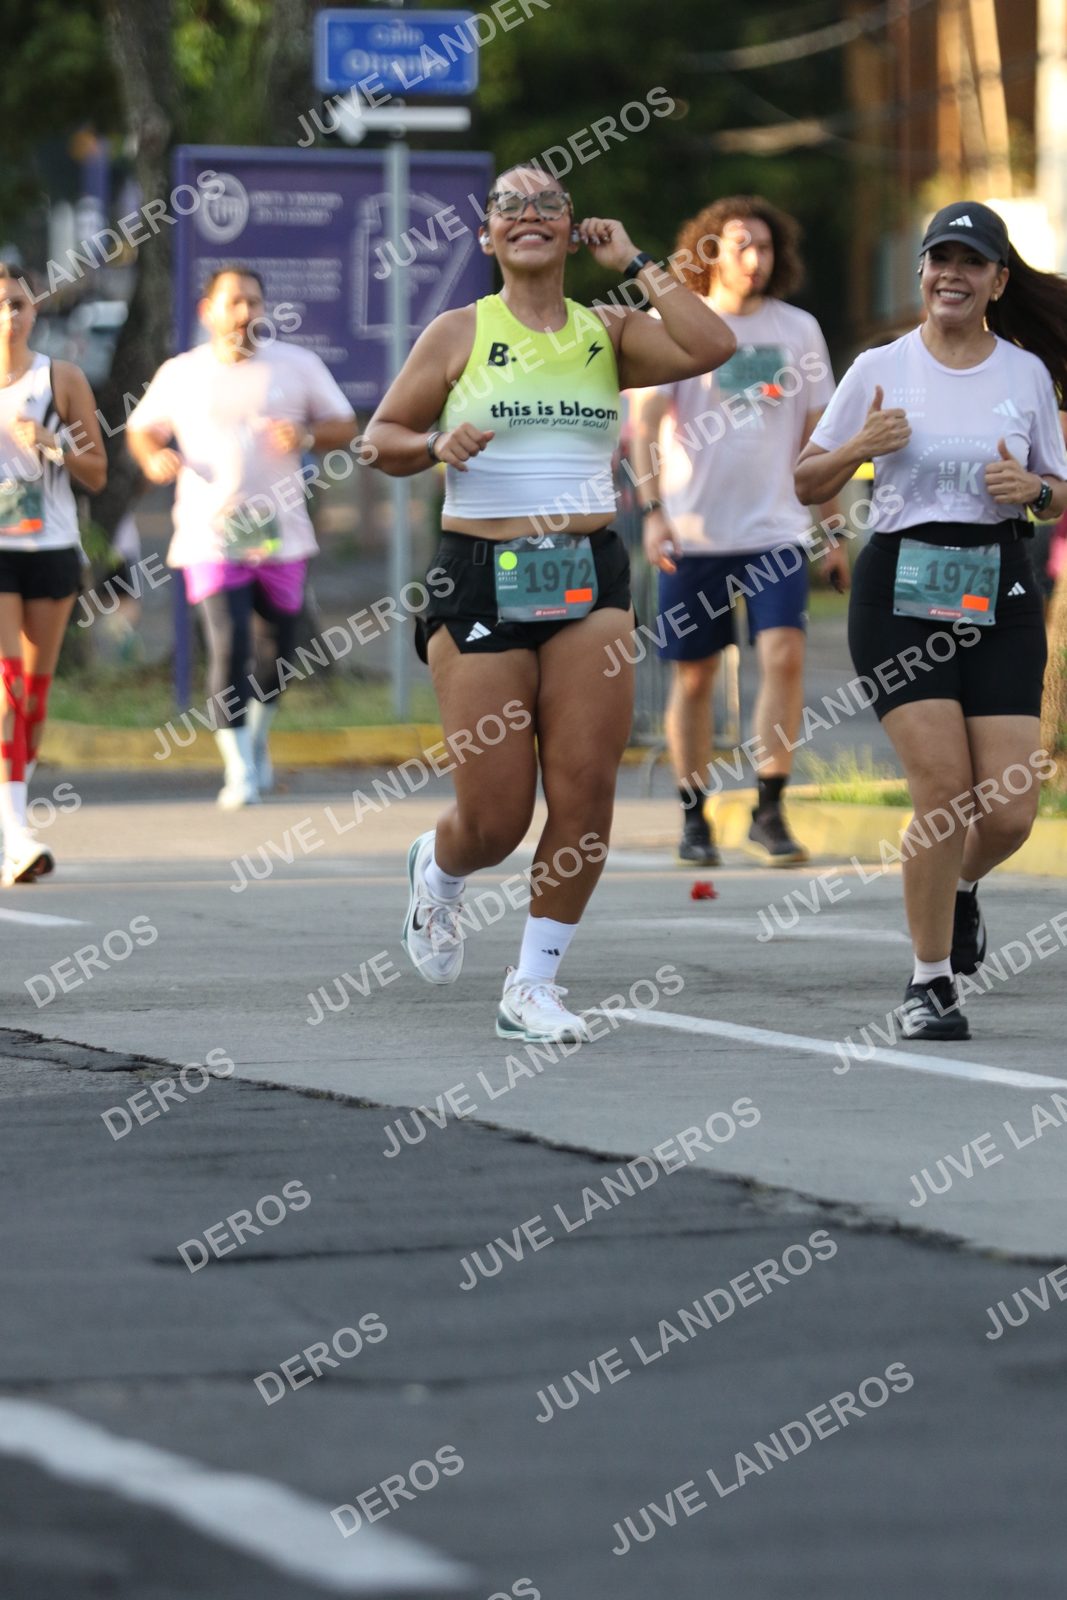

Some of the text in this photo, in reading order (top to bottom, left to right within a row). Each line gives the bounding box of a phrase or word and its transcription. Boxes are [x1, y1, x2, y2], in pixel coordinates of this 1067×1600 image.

[490, 401, 618, 420] this is bloom
[509, 416, 610, 430] (move your soul)
[938, 461, 956, 475] 15
[938, 480, 955, 493] 30
[960, 462, 982, 496] K
[524, 558, 595, 593] 1972
[924, 560, 996, 596] 1973
